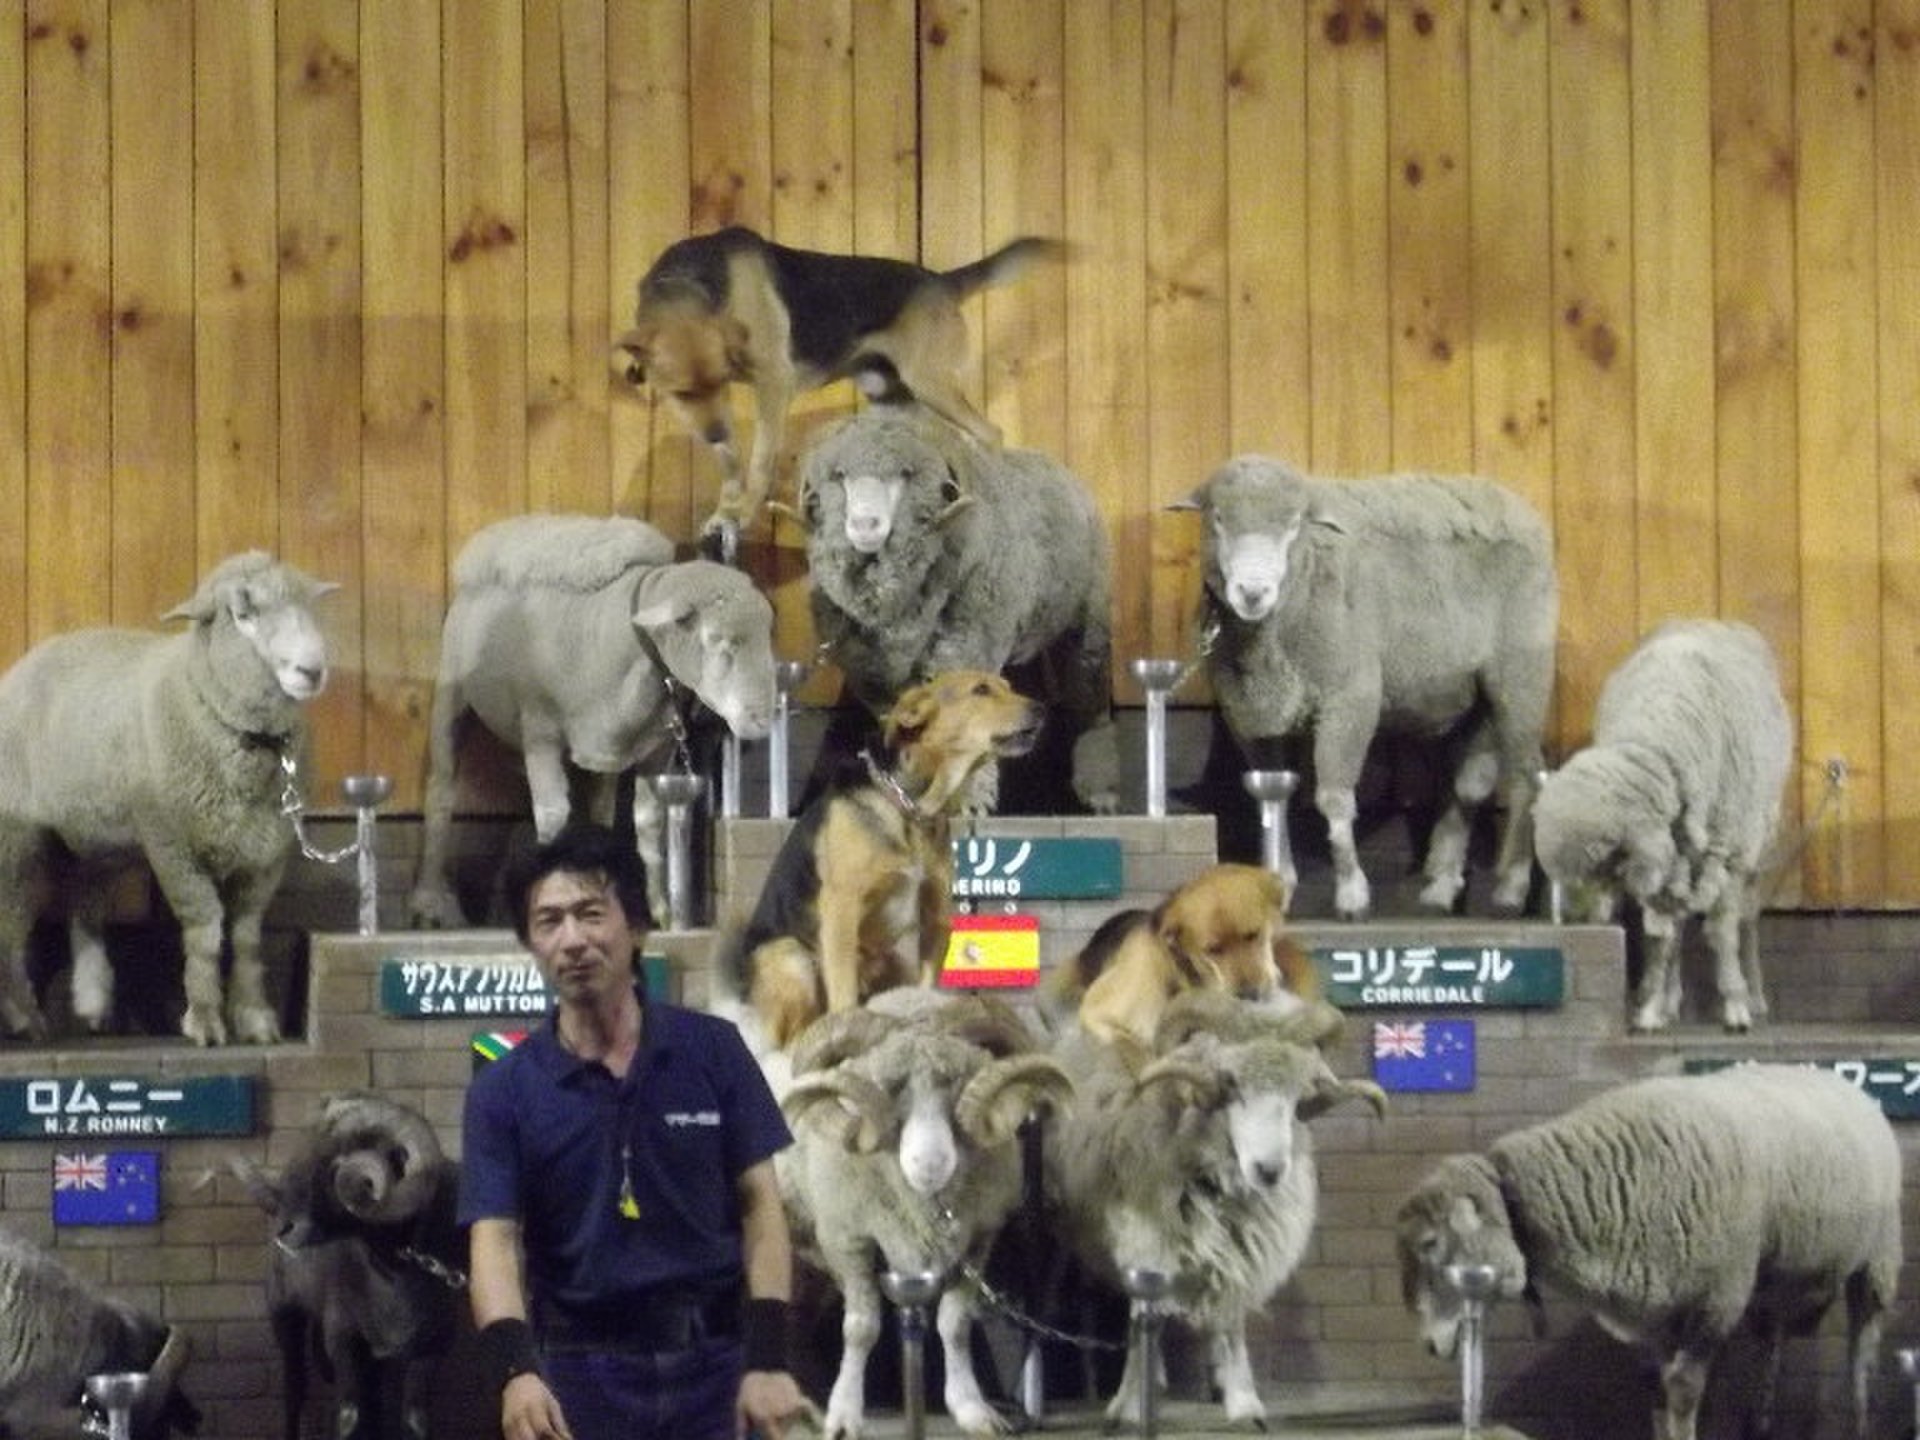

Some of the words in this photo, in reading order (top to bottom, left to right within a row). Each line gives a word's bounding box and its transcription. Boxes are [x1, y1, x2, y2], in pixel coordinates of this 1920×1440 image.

[952, 839, 1032, 876] リノ
[1331, 947, 1514, 985] コリデール
[419, 996, 456, 1013] S.A
[464, 995, 546, 1012] MUTTON
[1361, 986, 1485, 1003] CORRIEDALE
[26, 1080, 184, 1114] ロムニー
[44, 1116, 79, 1134] N.Z
[87, 1116, 168, 1134] ROMNEY
